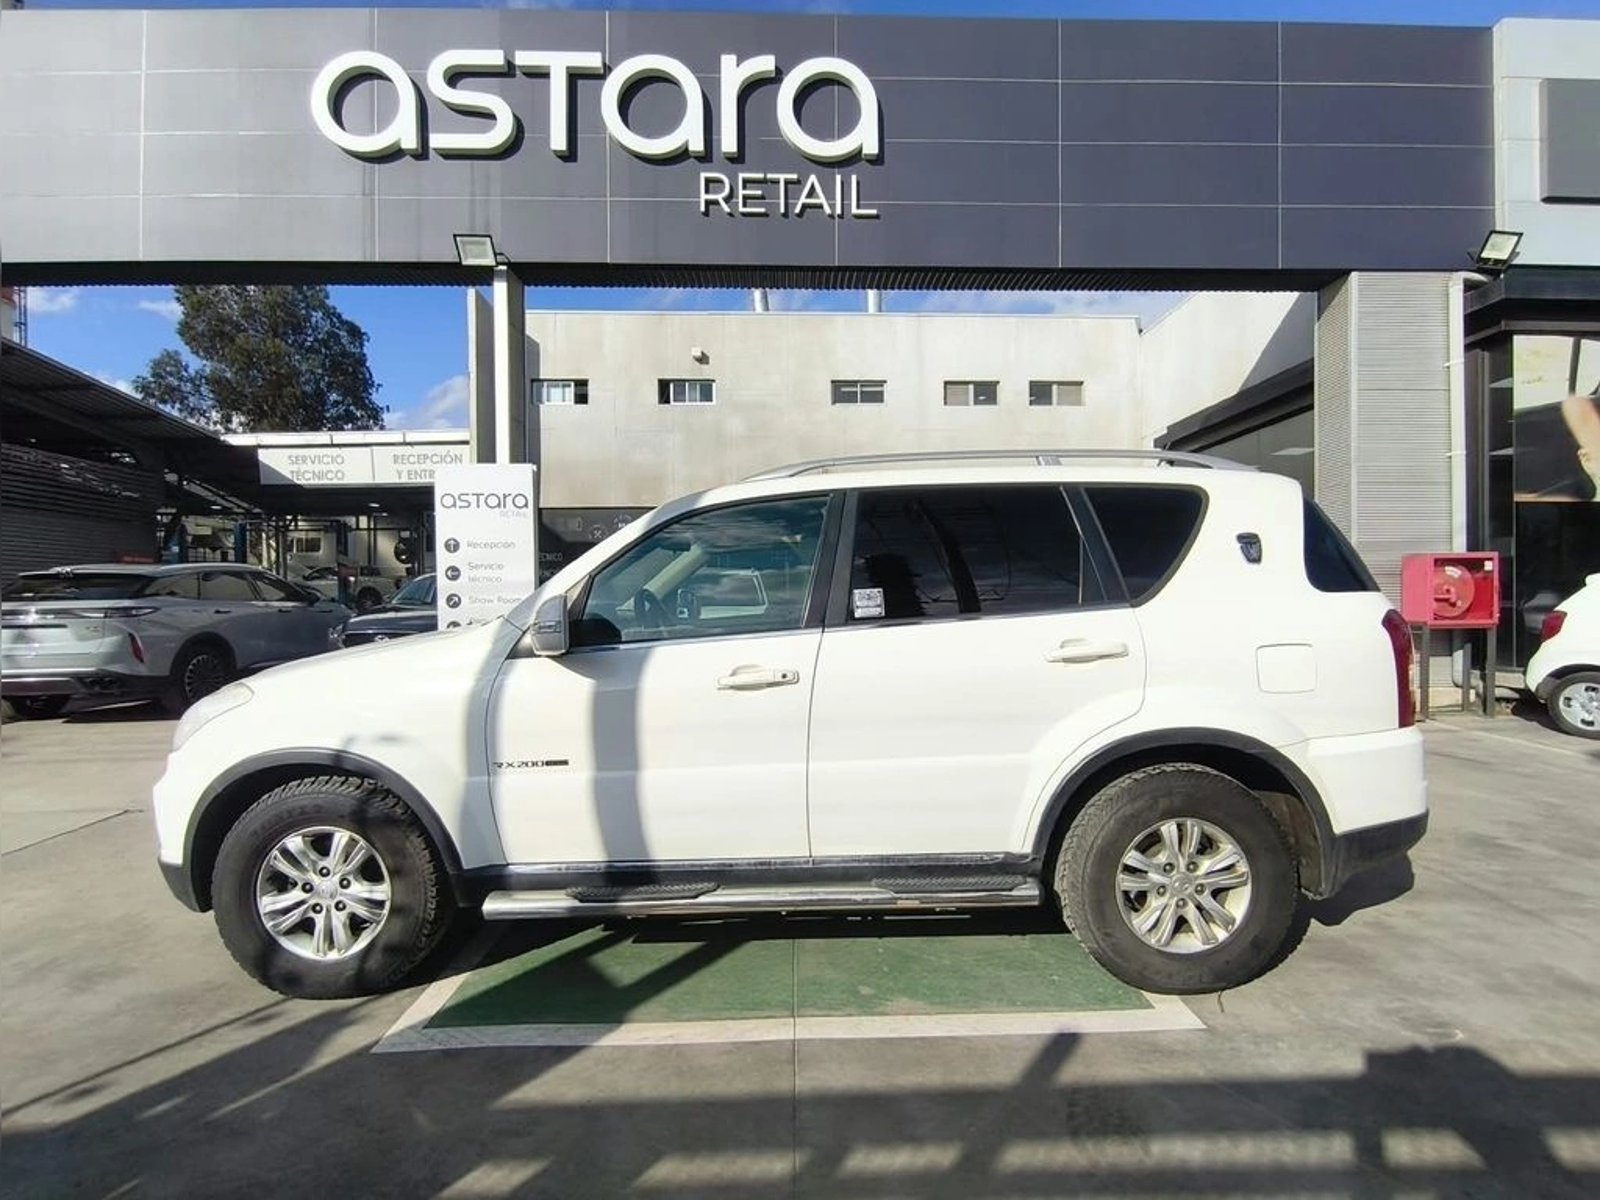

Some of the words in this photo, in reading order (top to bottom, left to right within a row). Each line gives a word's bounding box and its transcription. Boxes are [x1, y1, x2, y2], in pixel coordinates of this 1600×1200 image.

[699, 172, 878, 216] RETAIL
[288, 454, 345, 465] SERVICIO
[393, 449, 463, 465] RECEPCIÓN
[396, 469, 404, 480] Y
[407, 469, 436, 480] ENTR
